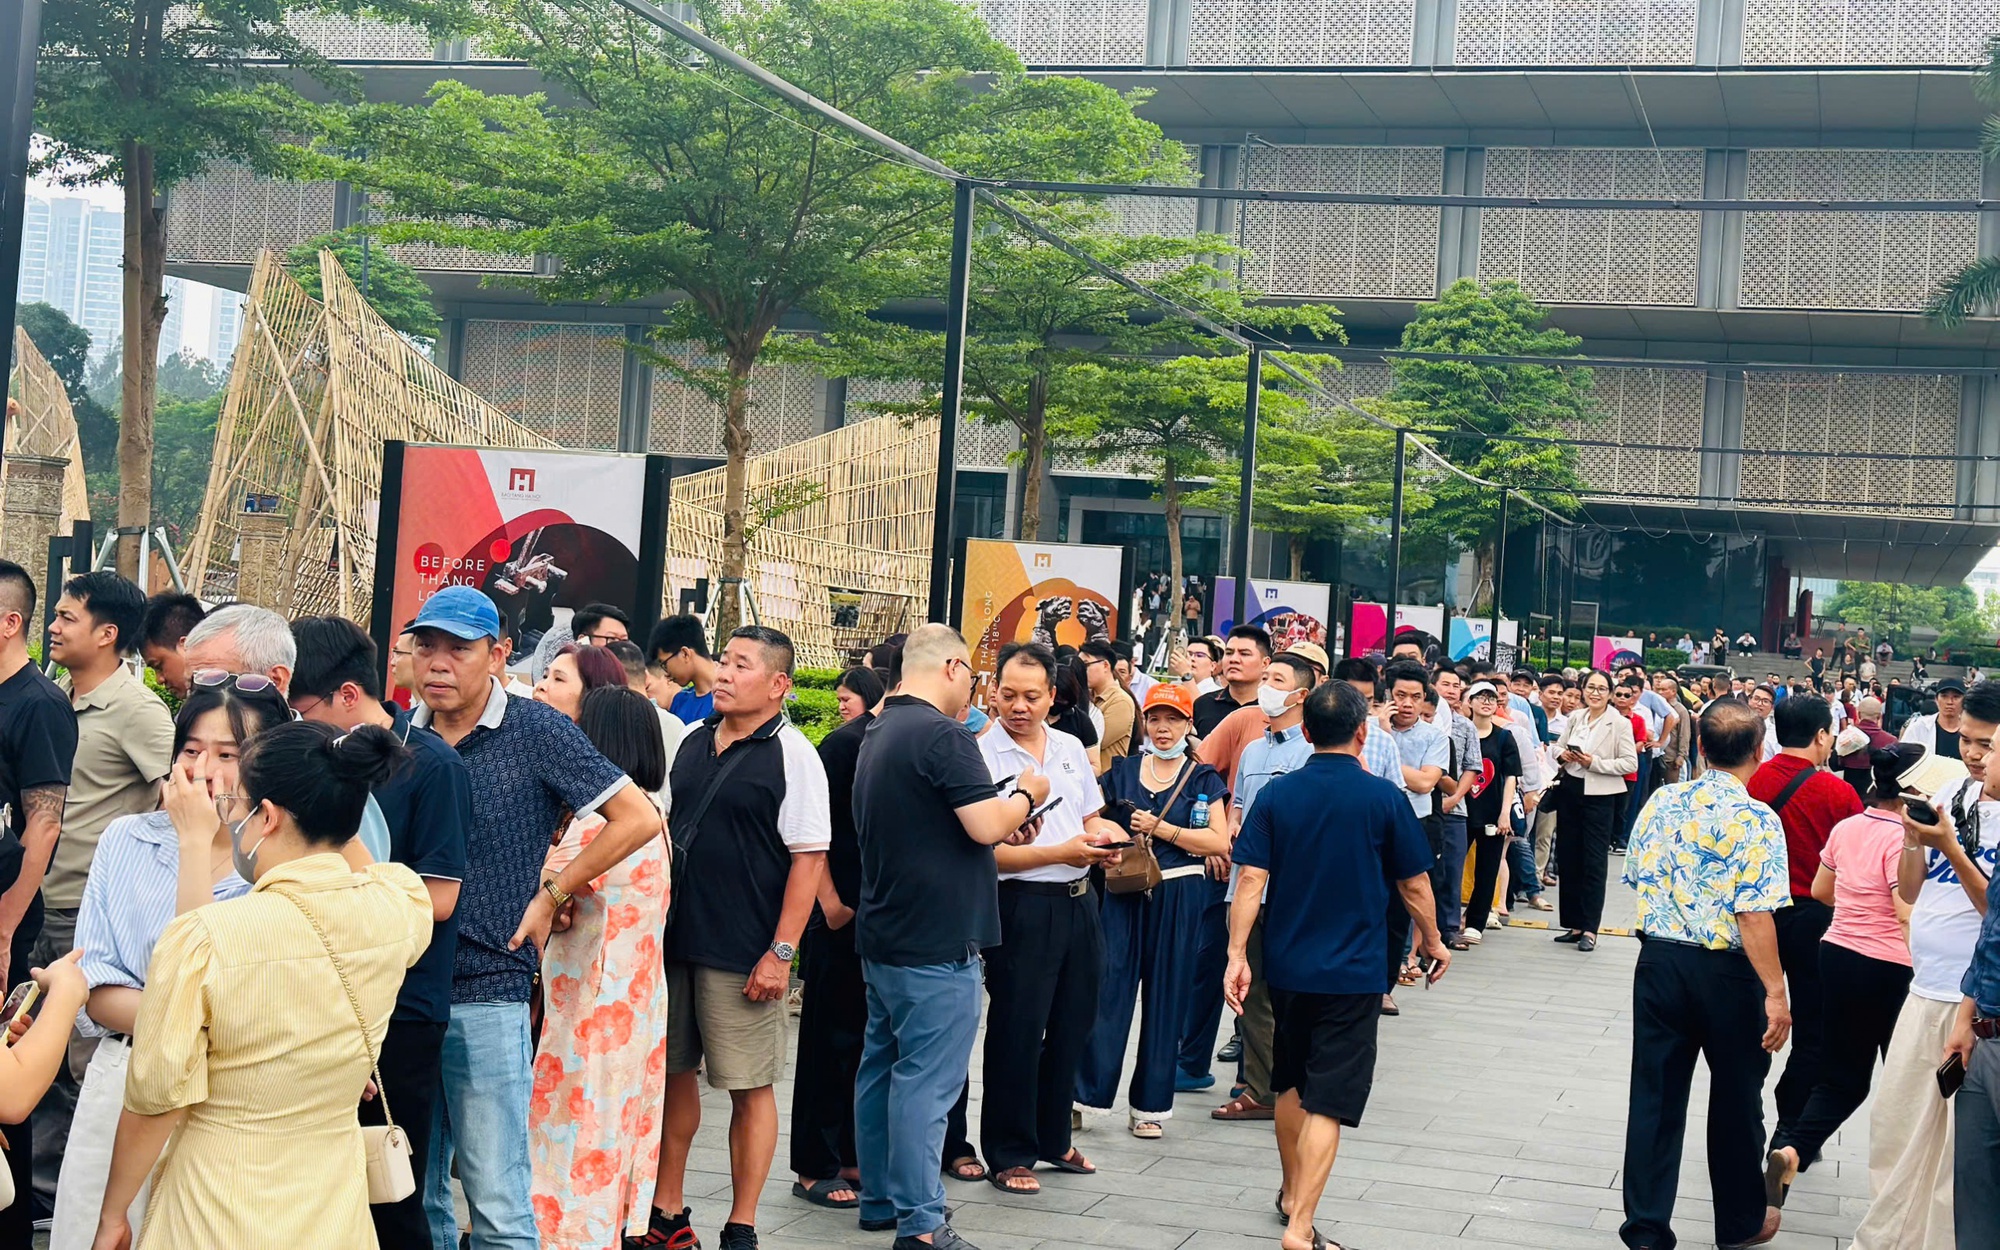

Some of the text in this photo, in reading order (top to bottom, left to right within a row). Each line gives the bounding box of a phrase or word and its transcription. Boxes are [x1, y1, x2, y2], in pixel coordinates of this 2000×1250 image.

[420, 555, 485, 572] BEFORE
[418, 572, 475, 588] THĂNG
[980, 590, 993, 665] THĂNG LONG
[1062, 762, 1070, 770] EY
